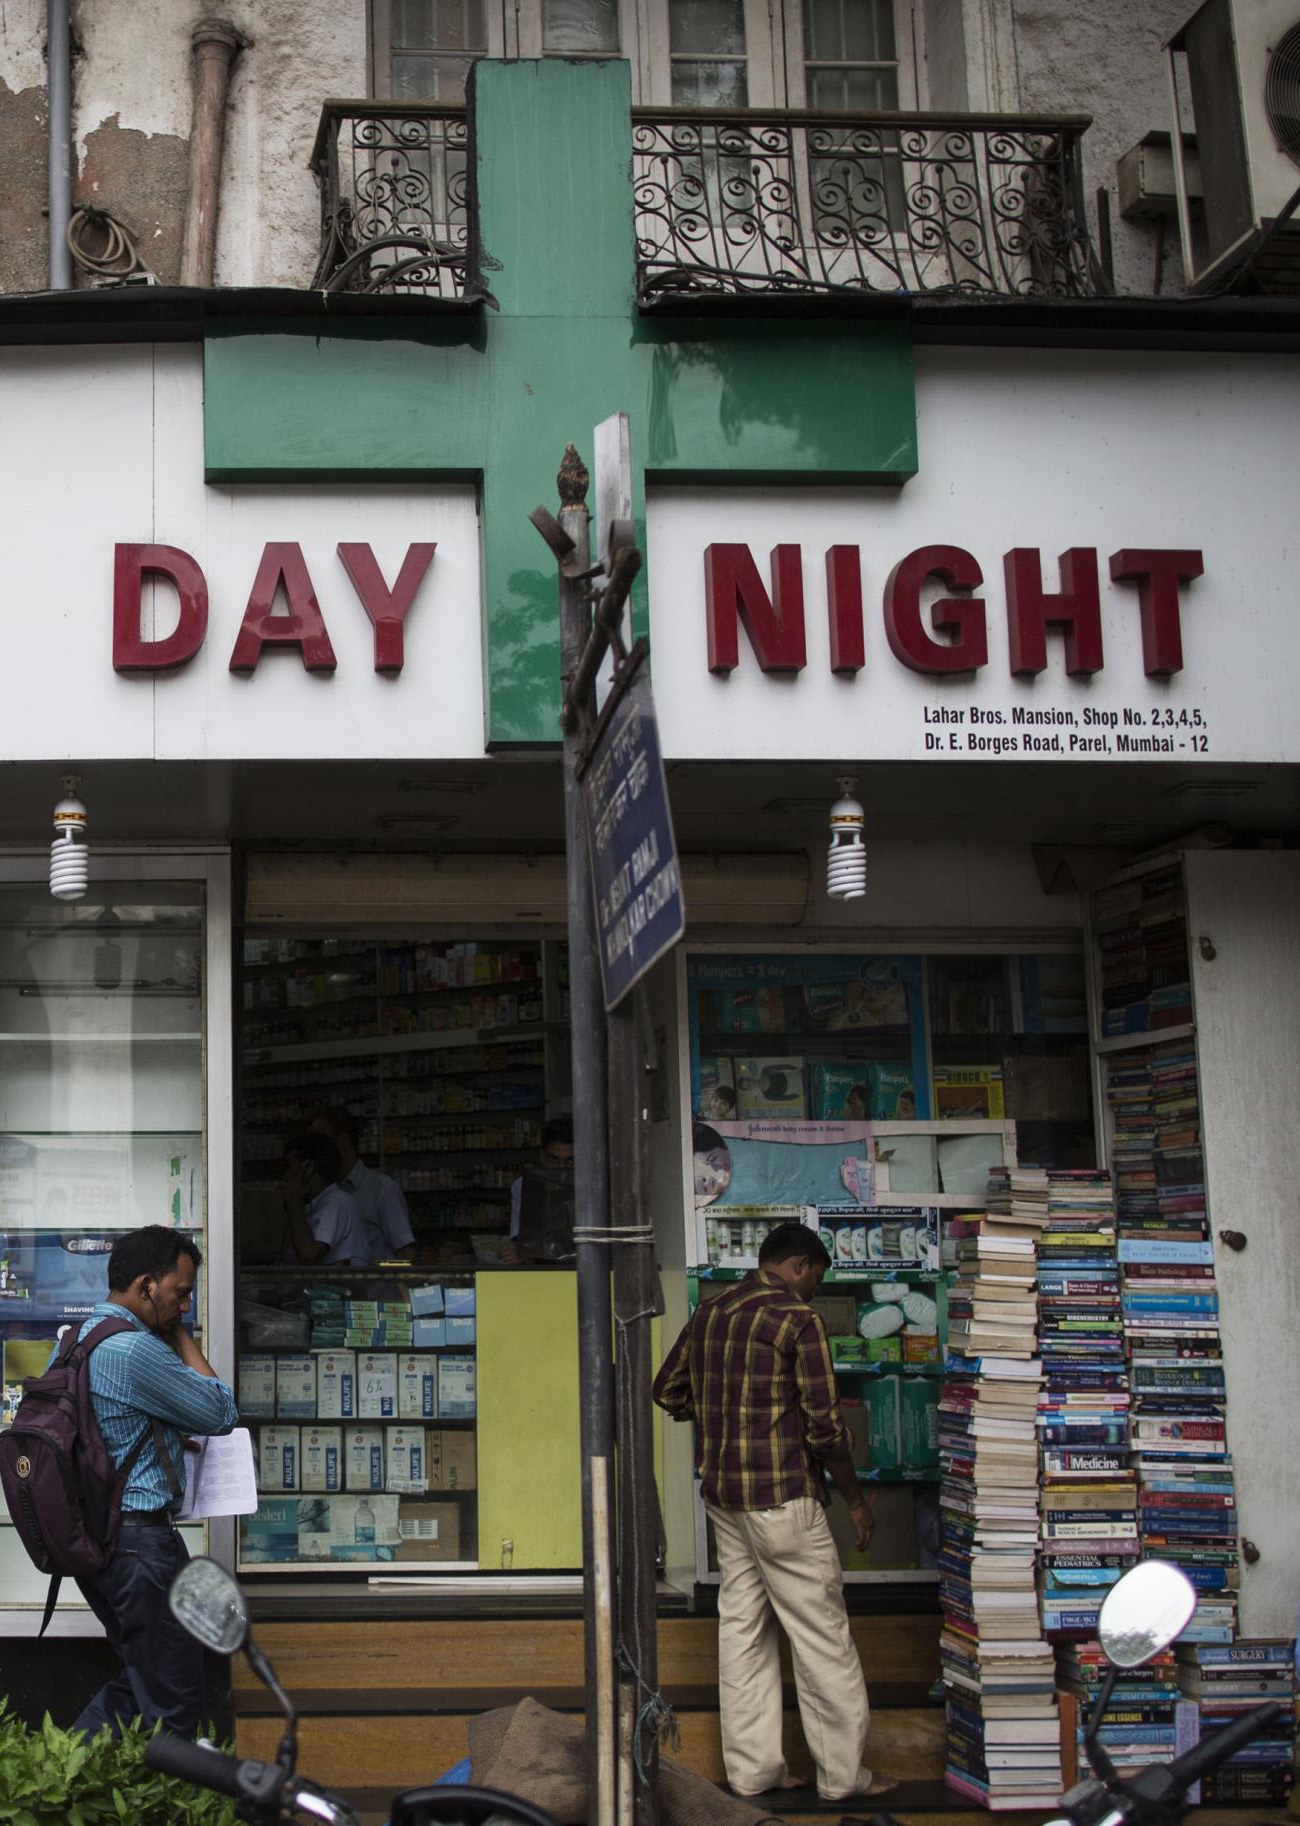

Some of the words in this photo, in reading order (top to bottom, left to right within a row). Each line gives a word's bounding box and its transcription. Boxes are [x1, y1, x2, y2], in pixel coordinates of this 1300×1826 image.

[112, 541, 438, 675] DAY
[703, 542, 1205, 679] NIGHT
[923, 705, 965, 725] Lahar
[969, 706, 1008, 725] Bros.
[1011, 707, 1080, 729] Mansion,
[1083, 707, 1118, 730] Shop
[1123, 707, 1147, 726] No.
[1151, 708, 1208, 729] 2,3,4,5,
[925, 732, 945, 751] Dr.
[949, 732, 963, 751] E.
[967, 733, 1019, 755] Borges
[1022, 733, 1065, 754] Road,
[1068, 734, 1112, 755] Parel,
[1116, 733, 1175, 753] Mumbai
[1190, 734, 1210, 753] 12
[67, 1238, 113, 1252] Gillette
[343, 1379, 352, 1412] NULIFE
[424, 1379, 432, 1412] NULIFE
[371, 1451, 380, 1484] NULIFE
[1071, 1457, 1120, 1469] Medicine
[1230, 1649, 1267, 1661] SURGERY
